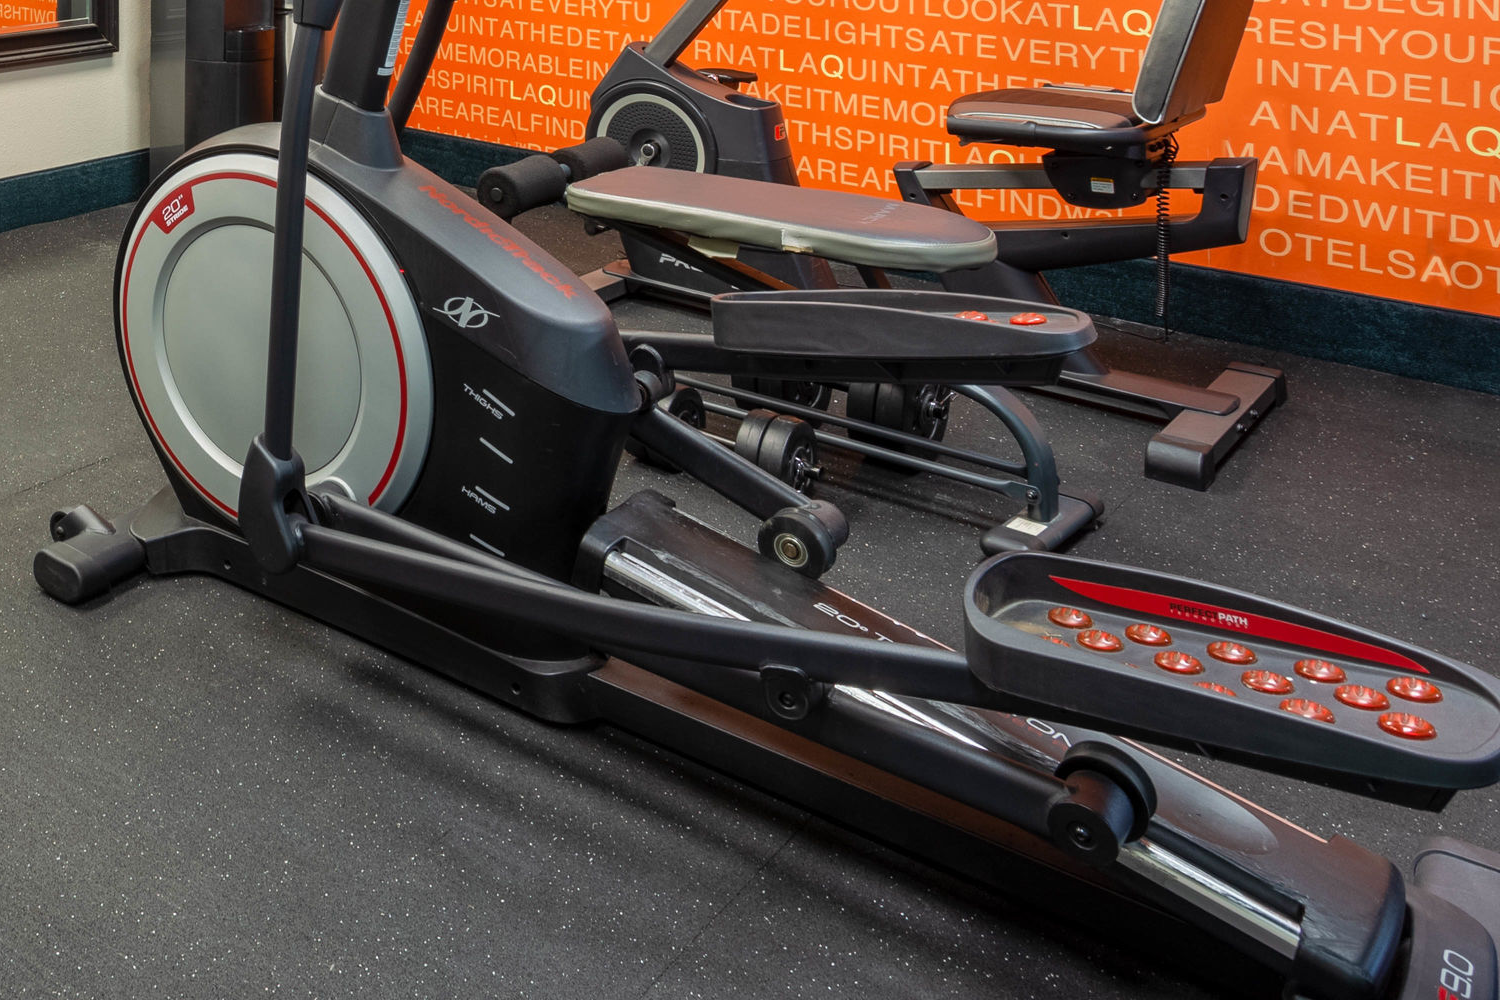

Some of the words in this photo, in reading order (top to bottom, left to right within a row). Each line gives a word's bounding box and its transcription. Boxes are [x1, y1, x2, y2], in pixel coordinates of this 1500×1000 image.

[705, 9, 1144, 73] NTADELIGHTSATEVERYT
[162, 194, 184, 221] 20"
[166, 204, 188, 227] STRIDE
[463, 383, 504, 420] THIGHS
[461, 485, 497, 515] HAMS
